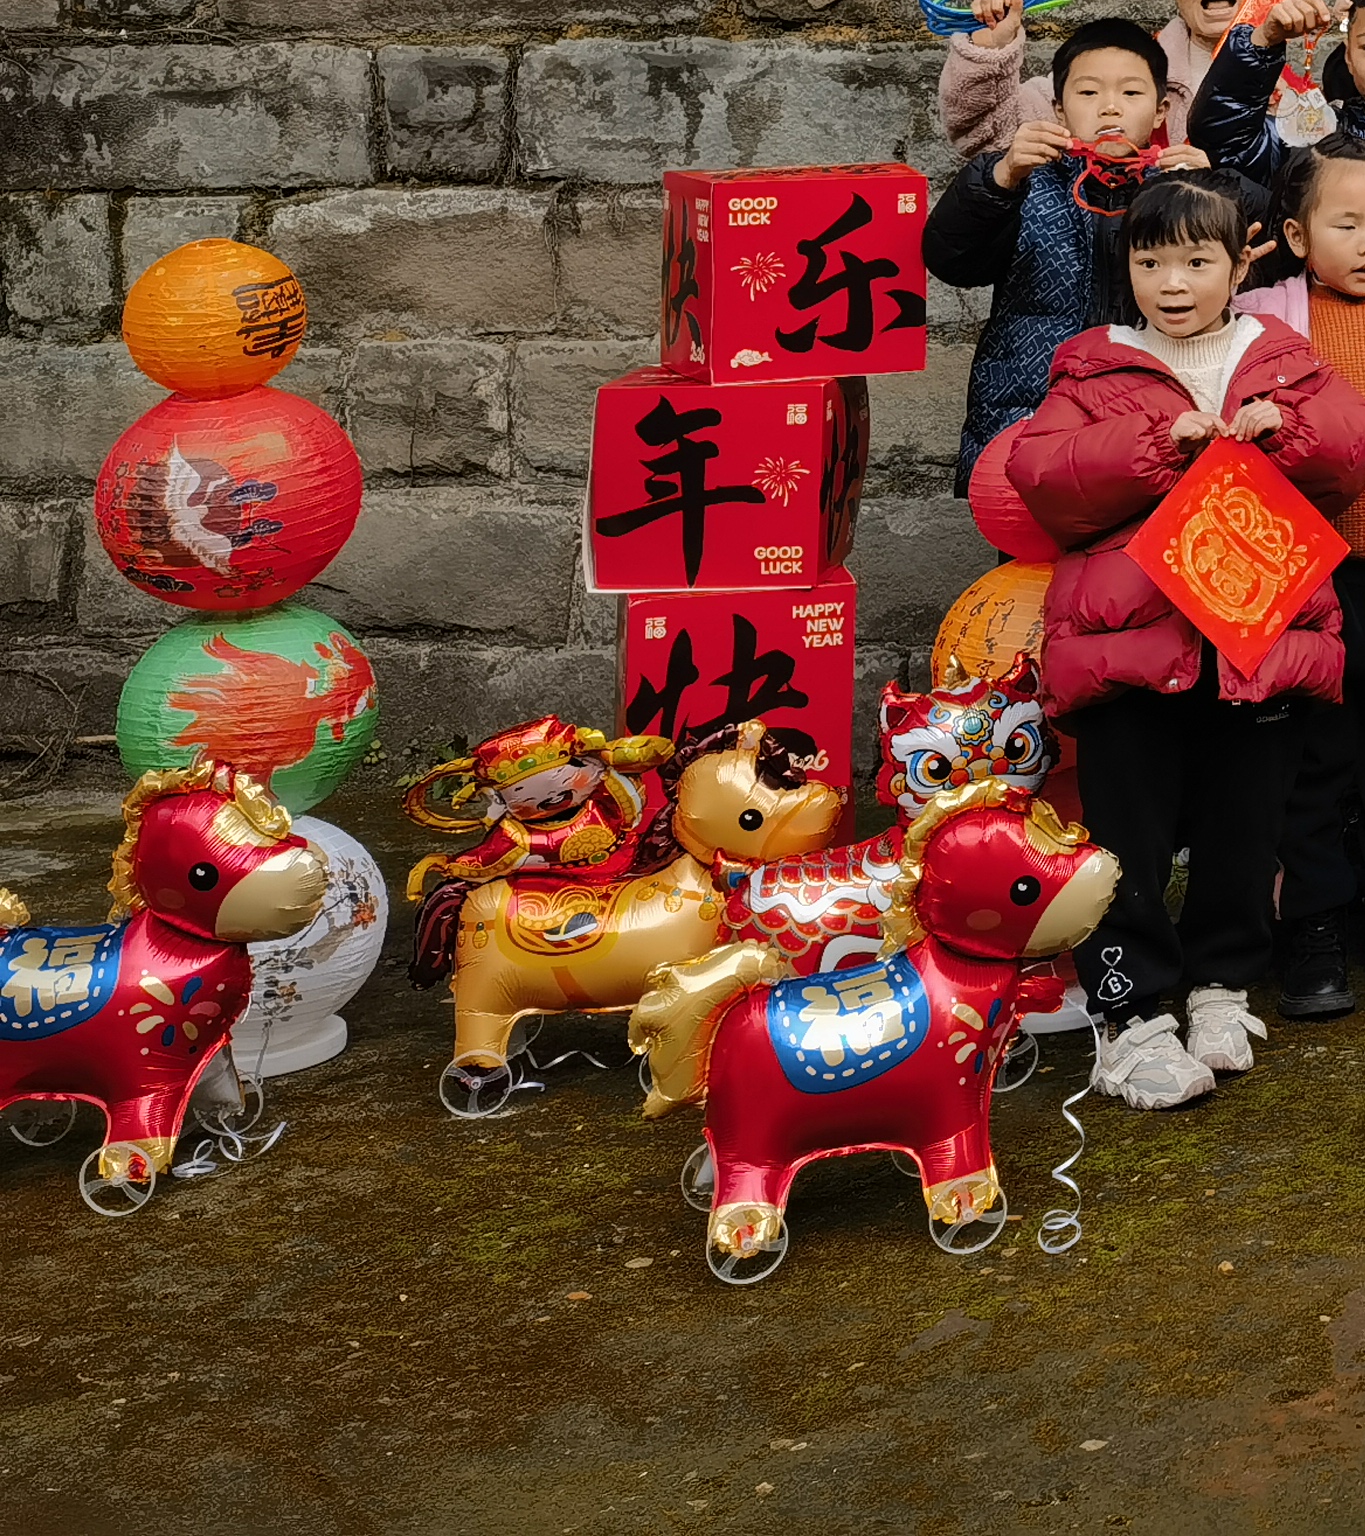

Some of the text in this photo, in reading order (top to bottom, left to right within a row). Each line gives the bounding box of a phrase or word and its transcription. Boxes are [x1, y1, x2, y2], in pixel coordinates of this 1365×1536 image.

[728, 196, 778, 211] GOOD
[728, 212, 771, 226] LUCK
[774, 191, 927, 353] 乐
[595, 394, 767, 589] 年
[753, 545, 803, 560] GOOD
[760, 561, 803, 575] LUCK
[792, 602, 845, 619] HAPPY
[806, 617, 844, 633] NEW
[802, 633, 843, 649] YEAR
[2, 932, 106, 1017] 福
[799, 974, 905, 1068] 福
